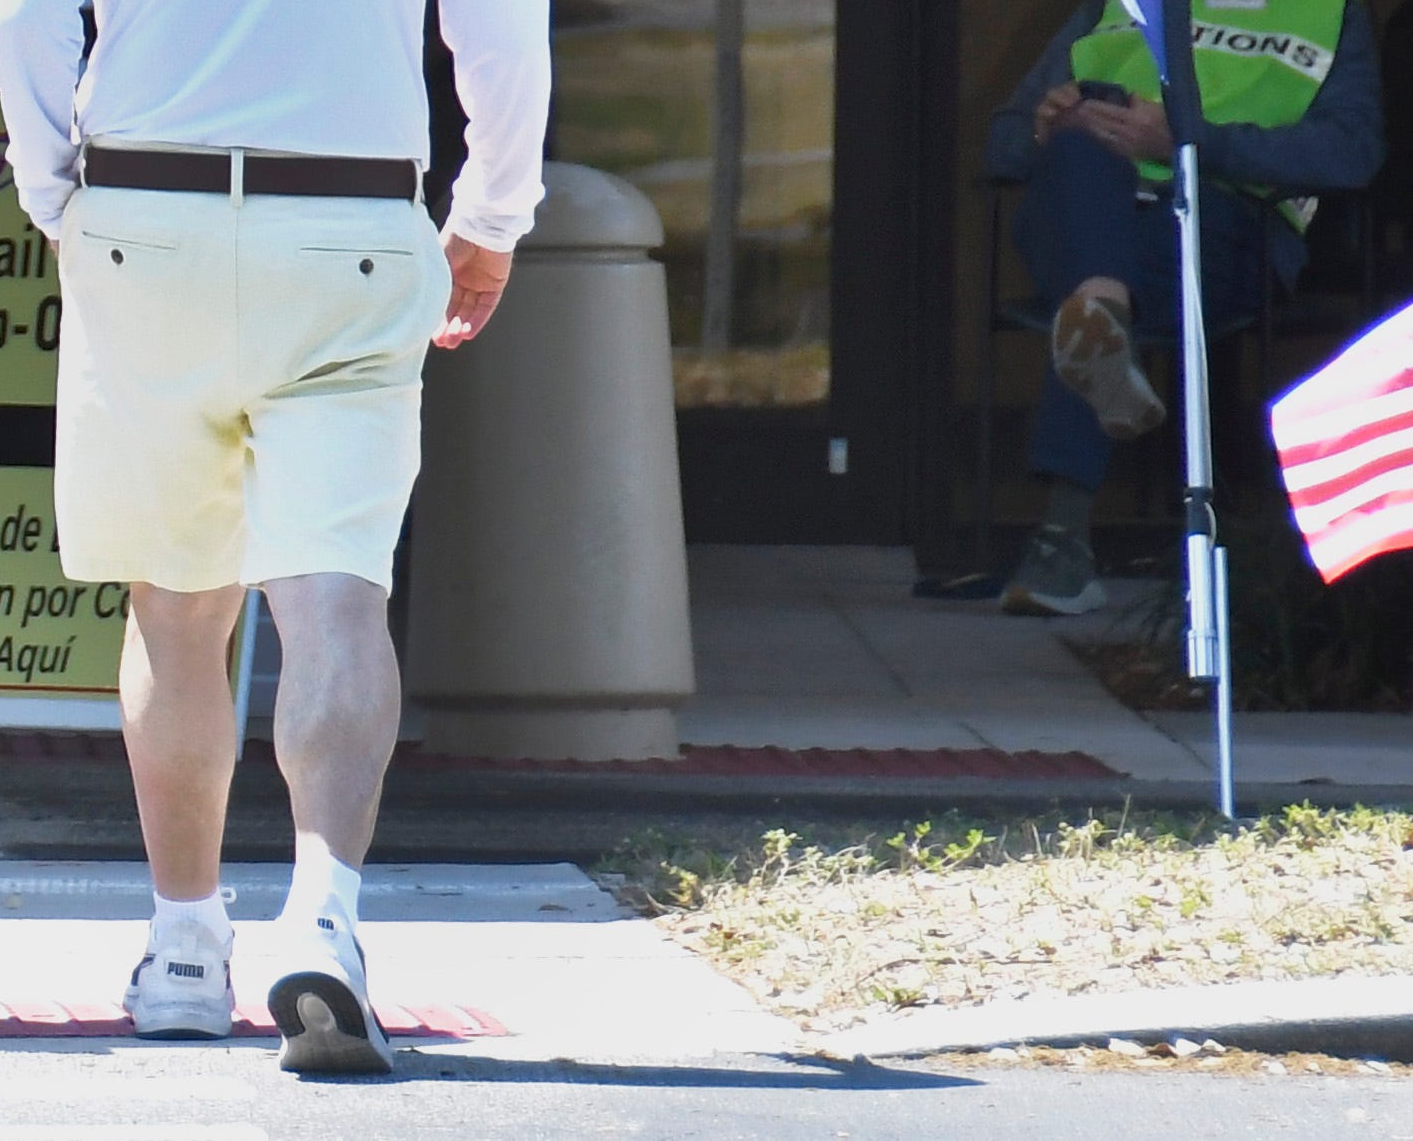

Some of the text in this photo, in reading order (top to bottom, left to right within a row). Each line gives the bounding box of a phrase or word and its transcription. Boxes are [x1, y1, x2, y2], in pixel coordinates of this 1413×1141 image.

[1195, 26, 1319, 69] TIONS
[0, 504, 41, 552] de
[20, 583, 86, 627] por
[167, 961, 204, 978] PUMA
